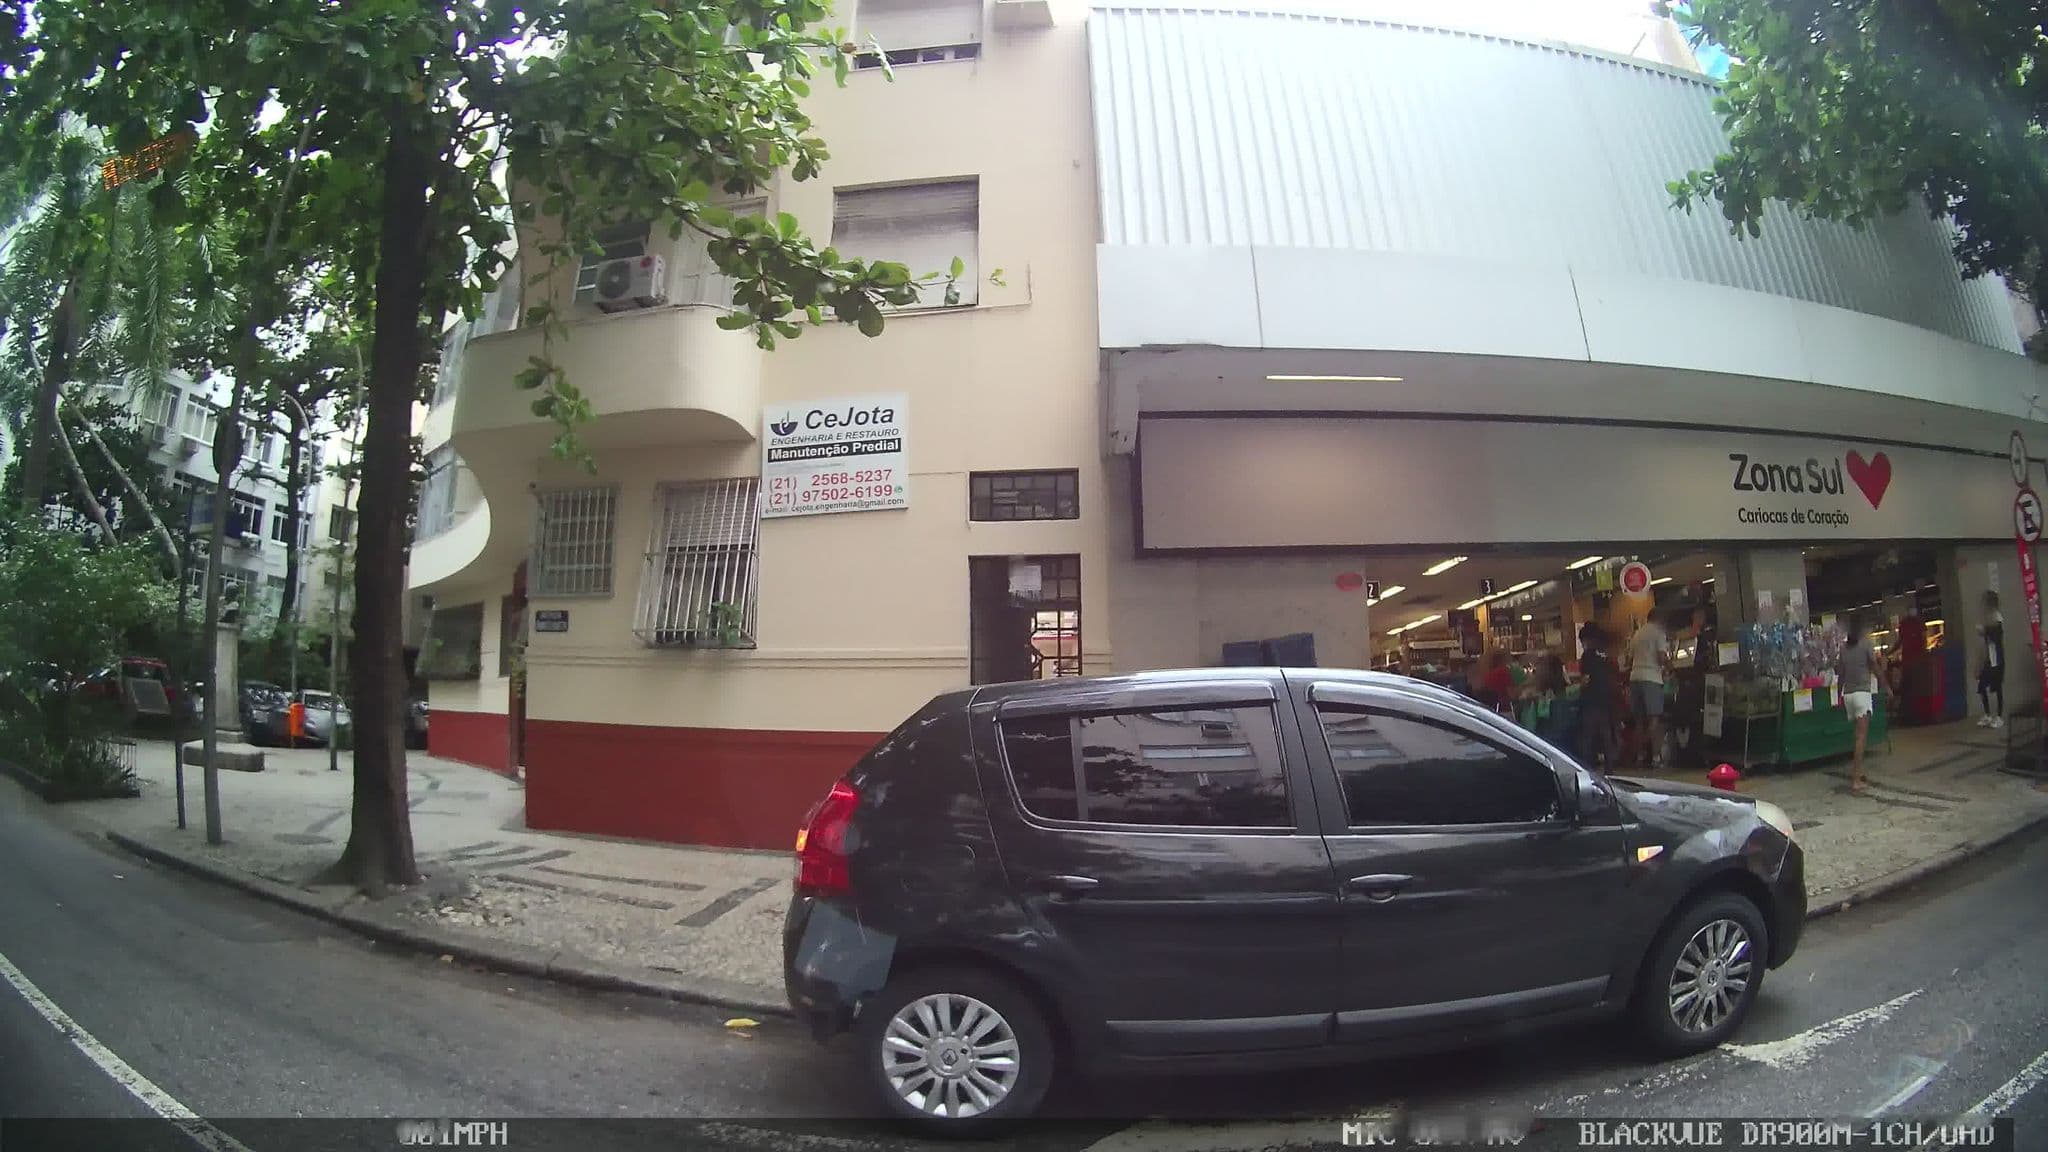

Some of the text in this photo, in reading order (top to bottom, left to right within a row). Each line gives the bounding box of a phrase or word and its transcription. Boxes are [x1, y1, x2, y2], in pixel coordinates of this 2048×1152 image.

[805, 406, 895, 430] CeJota
[771, 428, 900, 446] ENGENHARIA E RESTAURO
[771, 439, 899, 460] Manutenção Predial
[769, 469, 893, 493] (21) 2568-5237
[1729, 453, 1844, 495] Zona Sul
[769, 484, 893, 508] (21) 97502-6199
[1738, 507, 1849, 528] Cariocas de Coração
